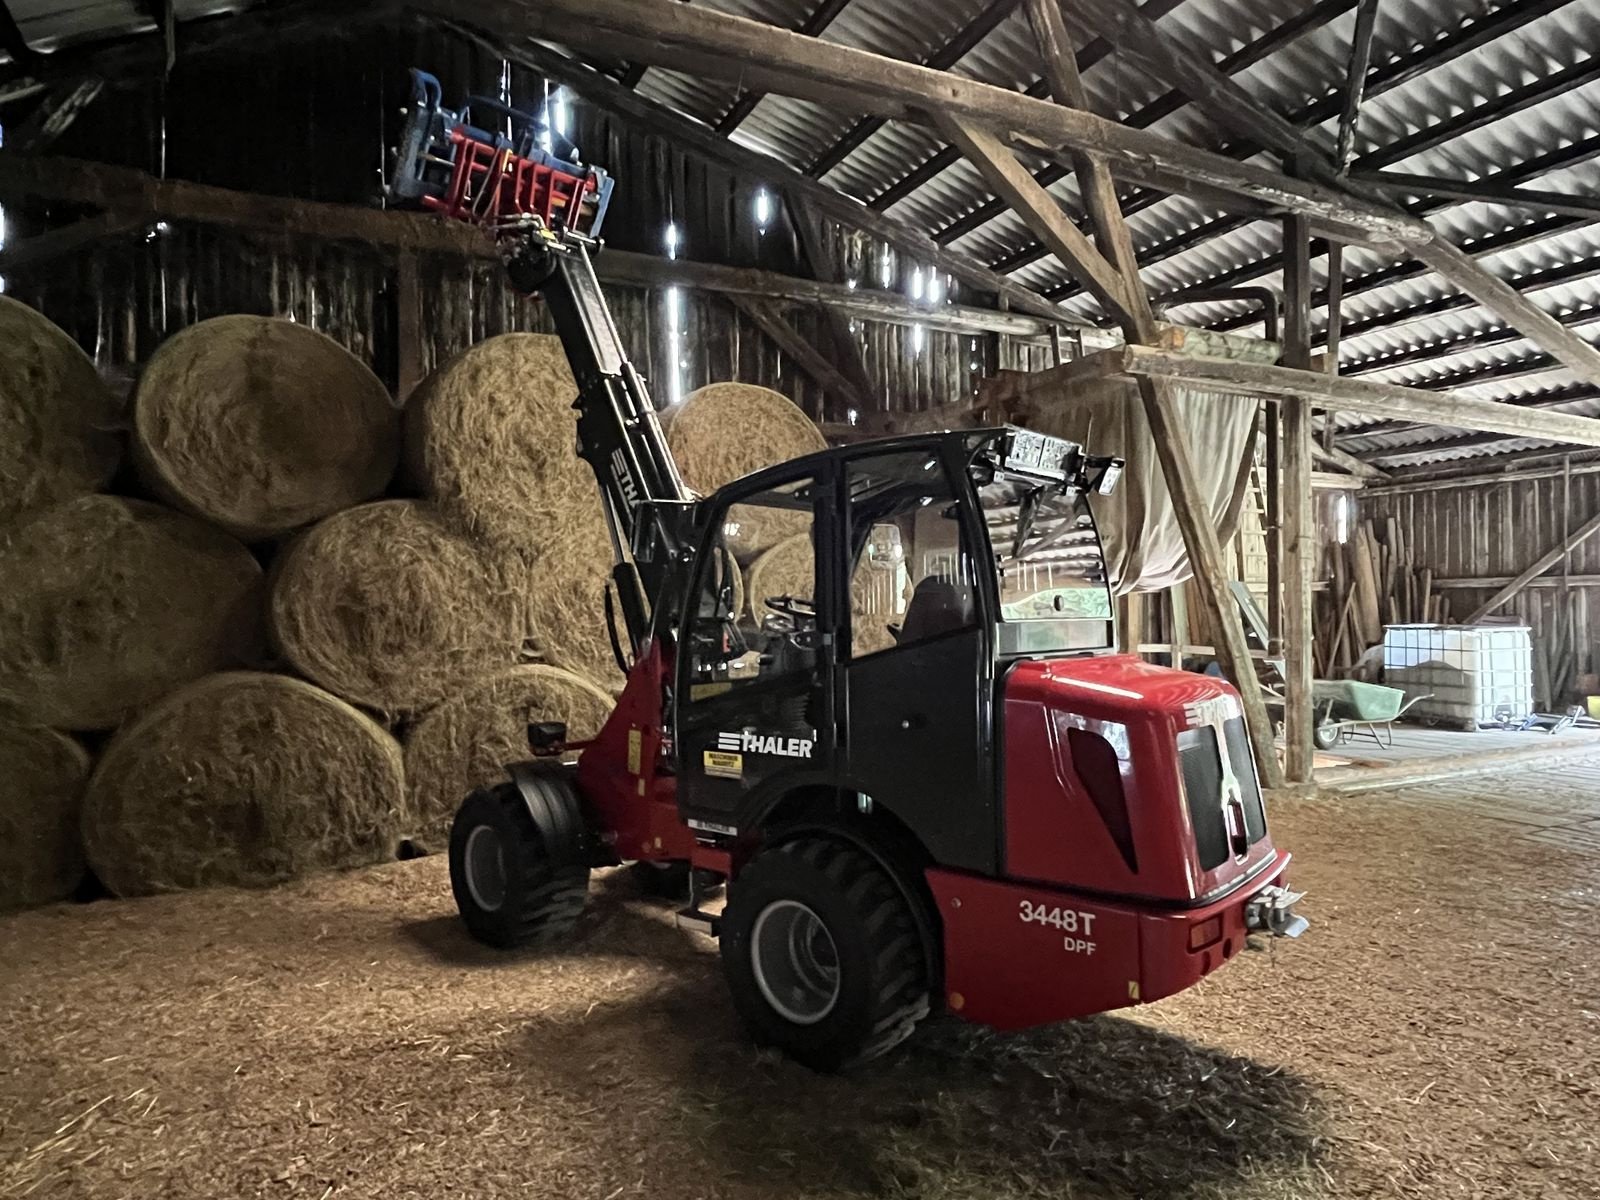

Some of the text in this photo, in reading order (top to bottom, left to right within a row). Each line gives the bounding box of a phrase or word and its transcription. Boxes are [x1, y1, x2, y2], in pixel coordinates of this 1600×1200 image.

[740, 734, 813, 758] THALER
[1019, 900, 1096, 936] 3448T
[1064, 936, 1096, 956] DPF
